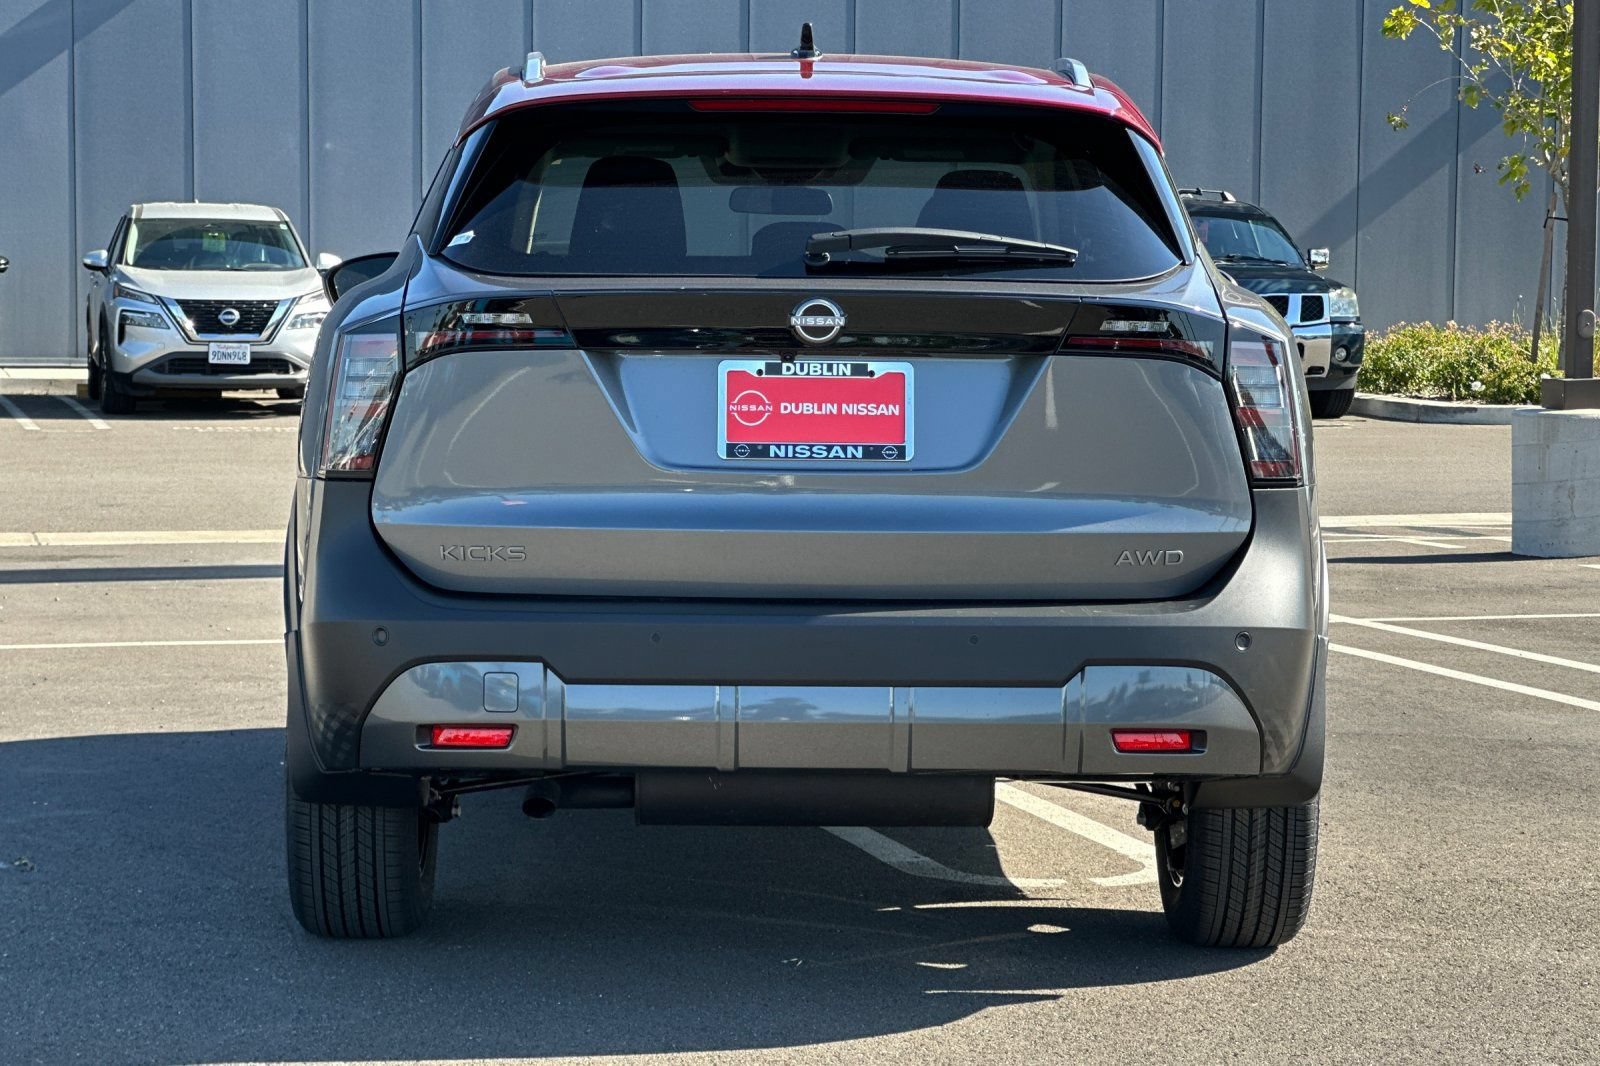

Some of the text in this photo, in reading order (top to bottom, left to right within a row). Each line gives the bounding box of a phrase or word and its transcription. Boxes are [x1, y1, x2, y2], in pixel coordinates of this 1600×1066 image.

[792, 317, 844, 325] NISSAN
[781, 363, 851, 376] DUBLIN
[729, 404, 773, 412] NISSAN
[780, 402, 900, 416] DUBLIN NISSAN
[769, 445, 863, 459] NISSAN
[440, 545, 527, 561] KICKS
[1114, 549, 1184, 566] AWD
